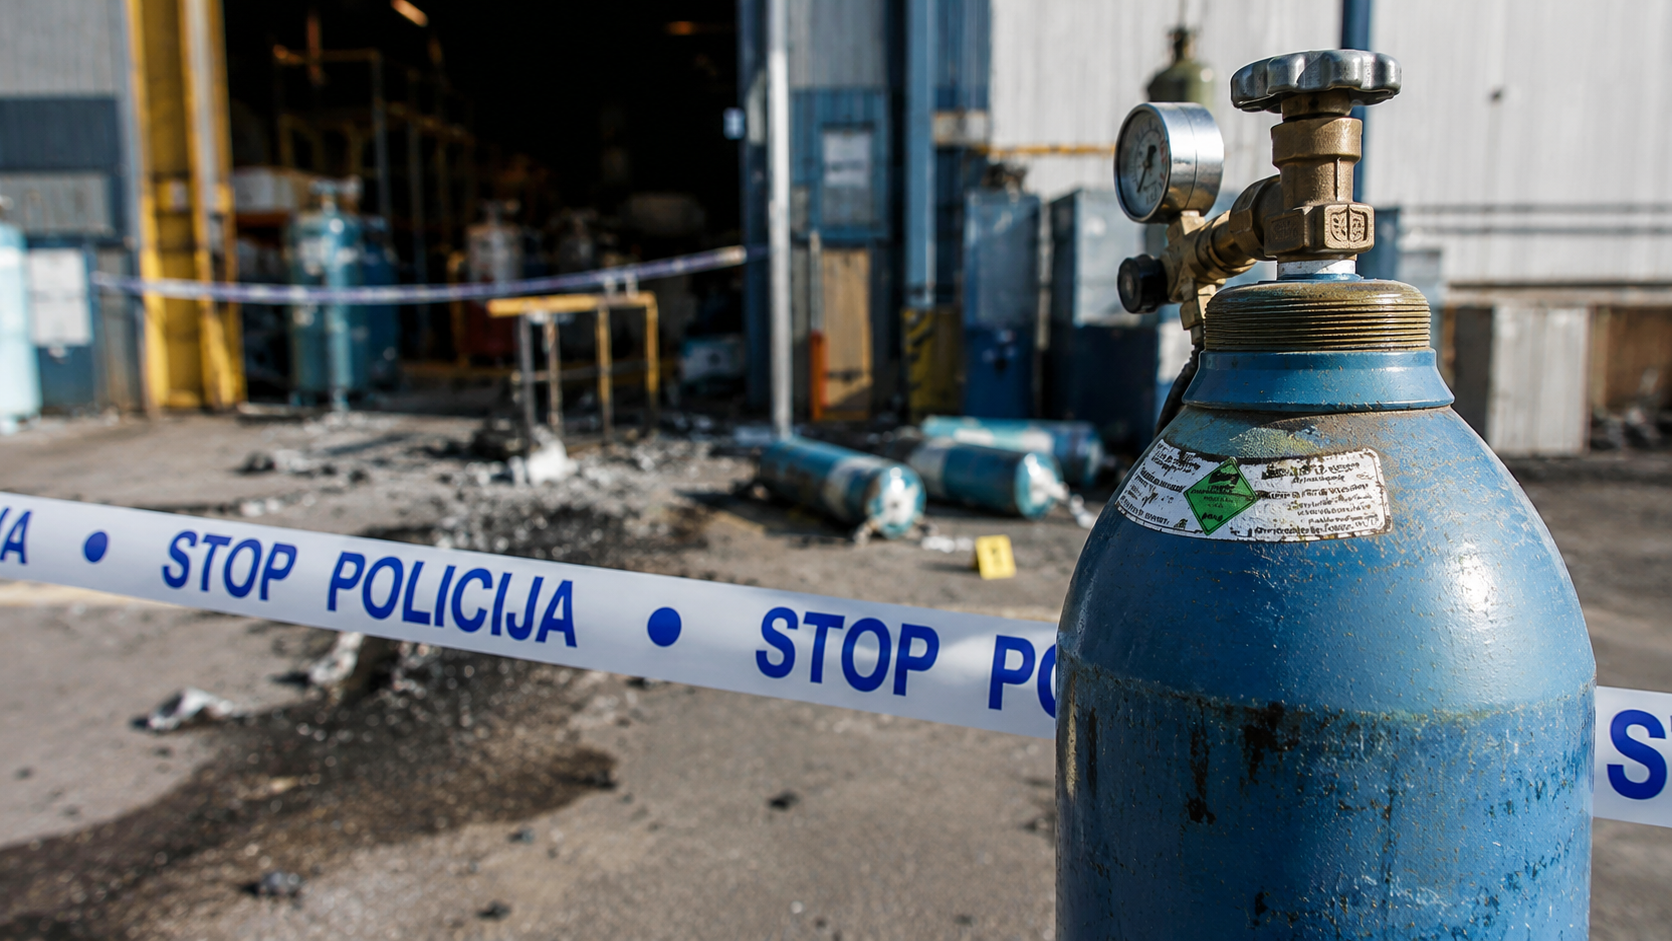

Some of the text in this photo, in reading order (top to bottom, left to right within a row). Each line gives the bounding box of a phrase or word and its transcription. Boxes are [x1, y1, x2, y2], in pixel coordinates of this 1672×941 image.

[162, 530, 298, 600] STOP
[327, 551, 578, 649] POLICIJA
[755, 606, 940, 697] STOP
[1606, 709, 1672, 801] S
